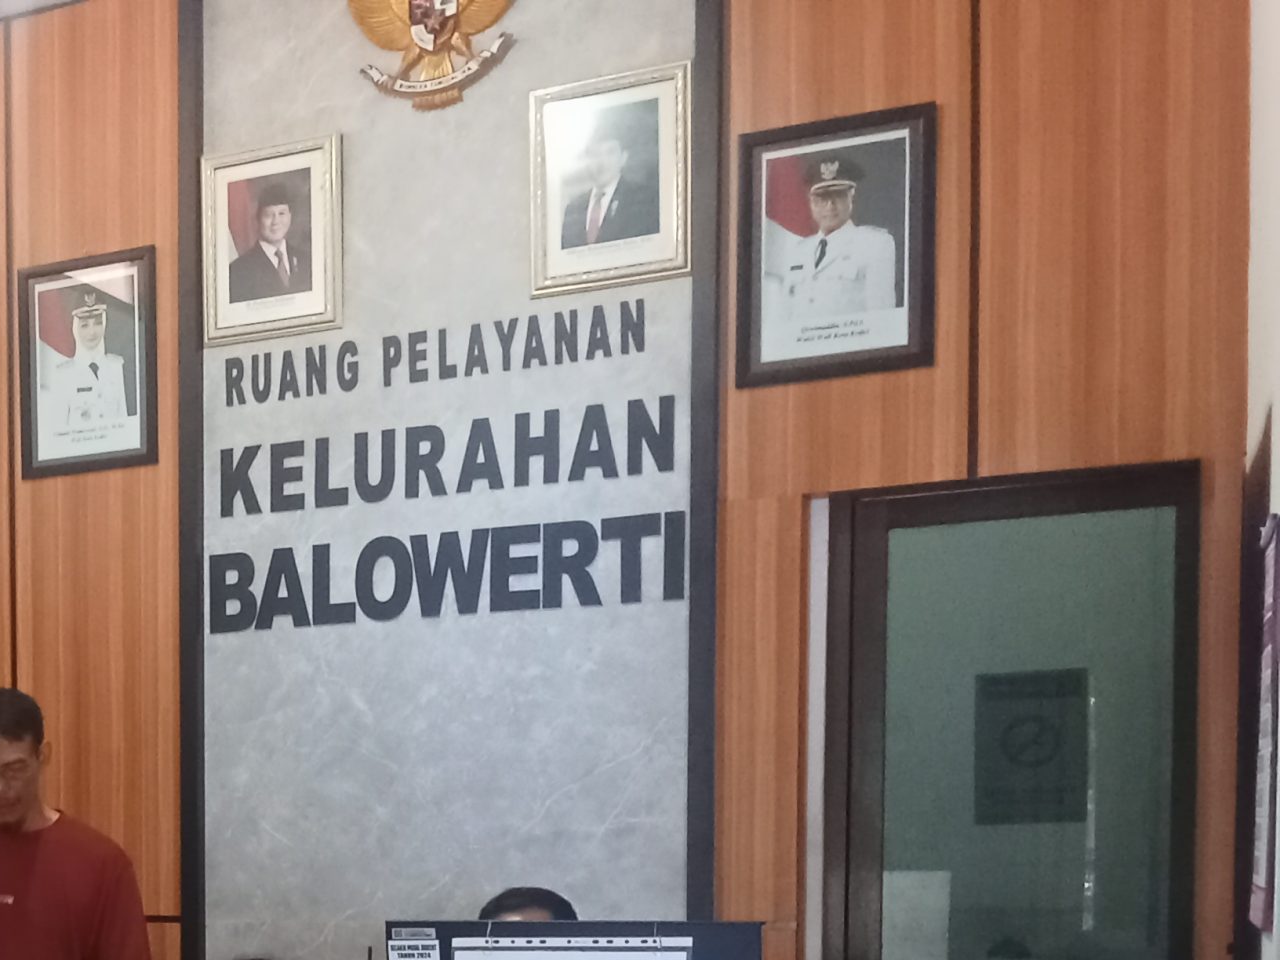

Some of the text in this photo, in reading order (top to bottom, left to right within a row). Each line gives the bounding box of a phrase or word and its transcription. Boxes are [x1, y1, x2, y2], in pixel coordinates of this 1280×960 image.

[225, 298, 646, 407] RUANG PELAYANAN
[219, 394, 676, 518] KELURAHAN
[208, 511, 686, 635] BALOWERTI
